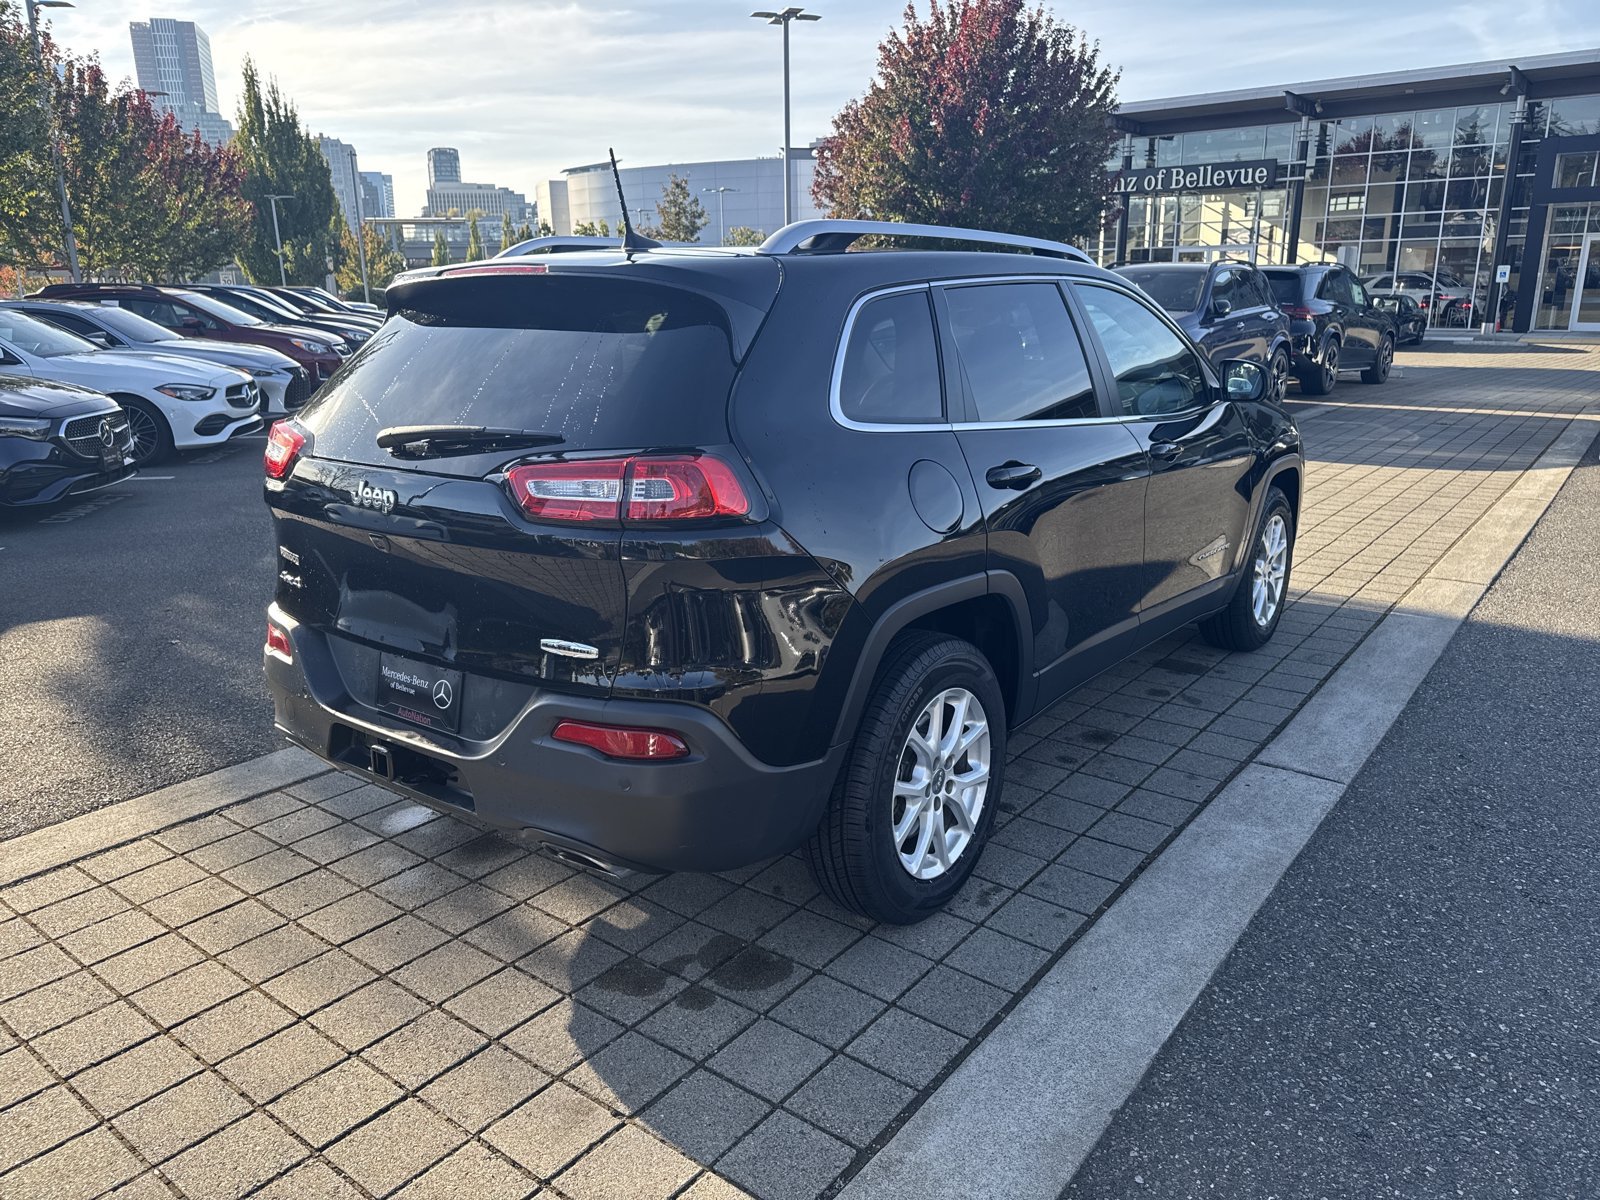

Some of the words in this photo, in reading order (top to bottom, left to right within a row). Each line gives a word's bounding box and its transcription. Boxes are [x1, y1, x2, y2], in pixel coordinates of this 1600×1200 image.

[1144, 168, 1167, 191] of
[1169, 165, 1268, 189] Bellevue
[351, 479, 395, 514] Jeep
[382, 665, 429, 689] Mercedes-Benz
[390, 681, 396, 689] of
[395, 682, 415, 695] Bellevue
[397, 707, 431, 726] AutoNation
